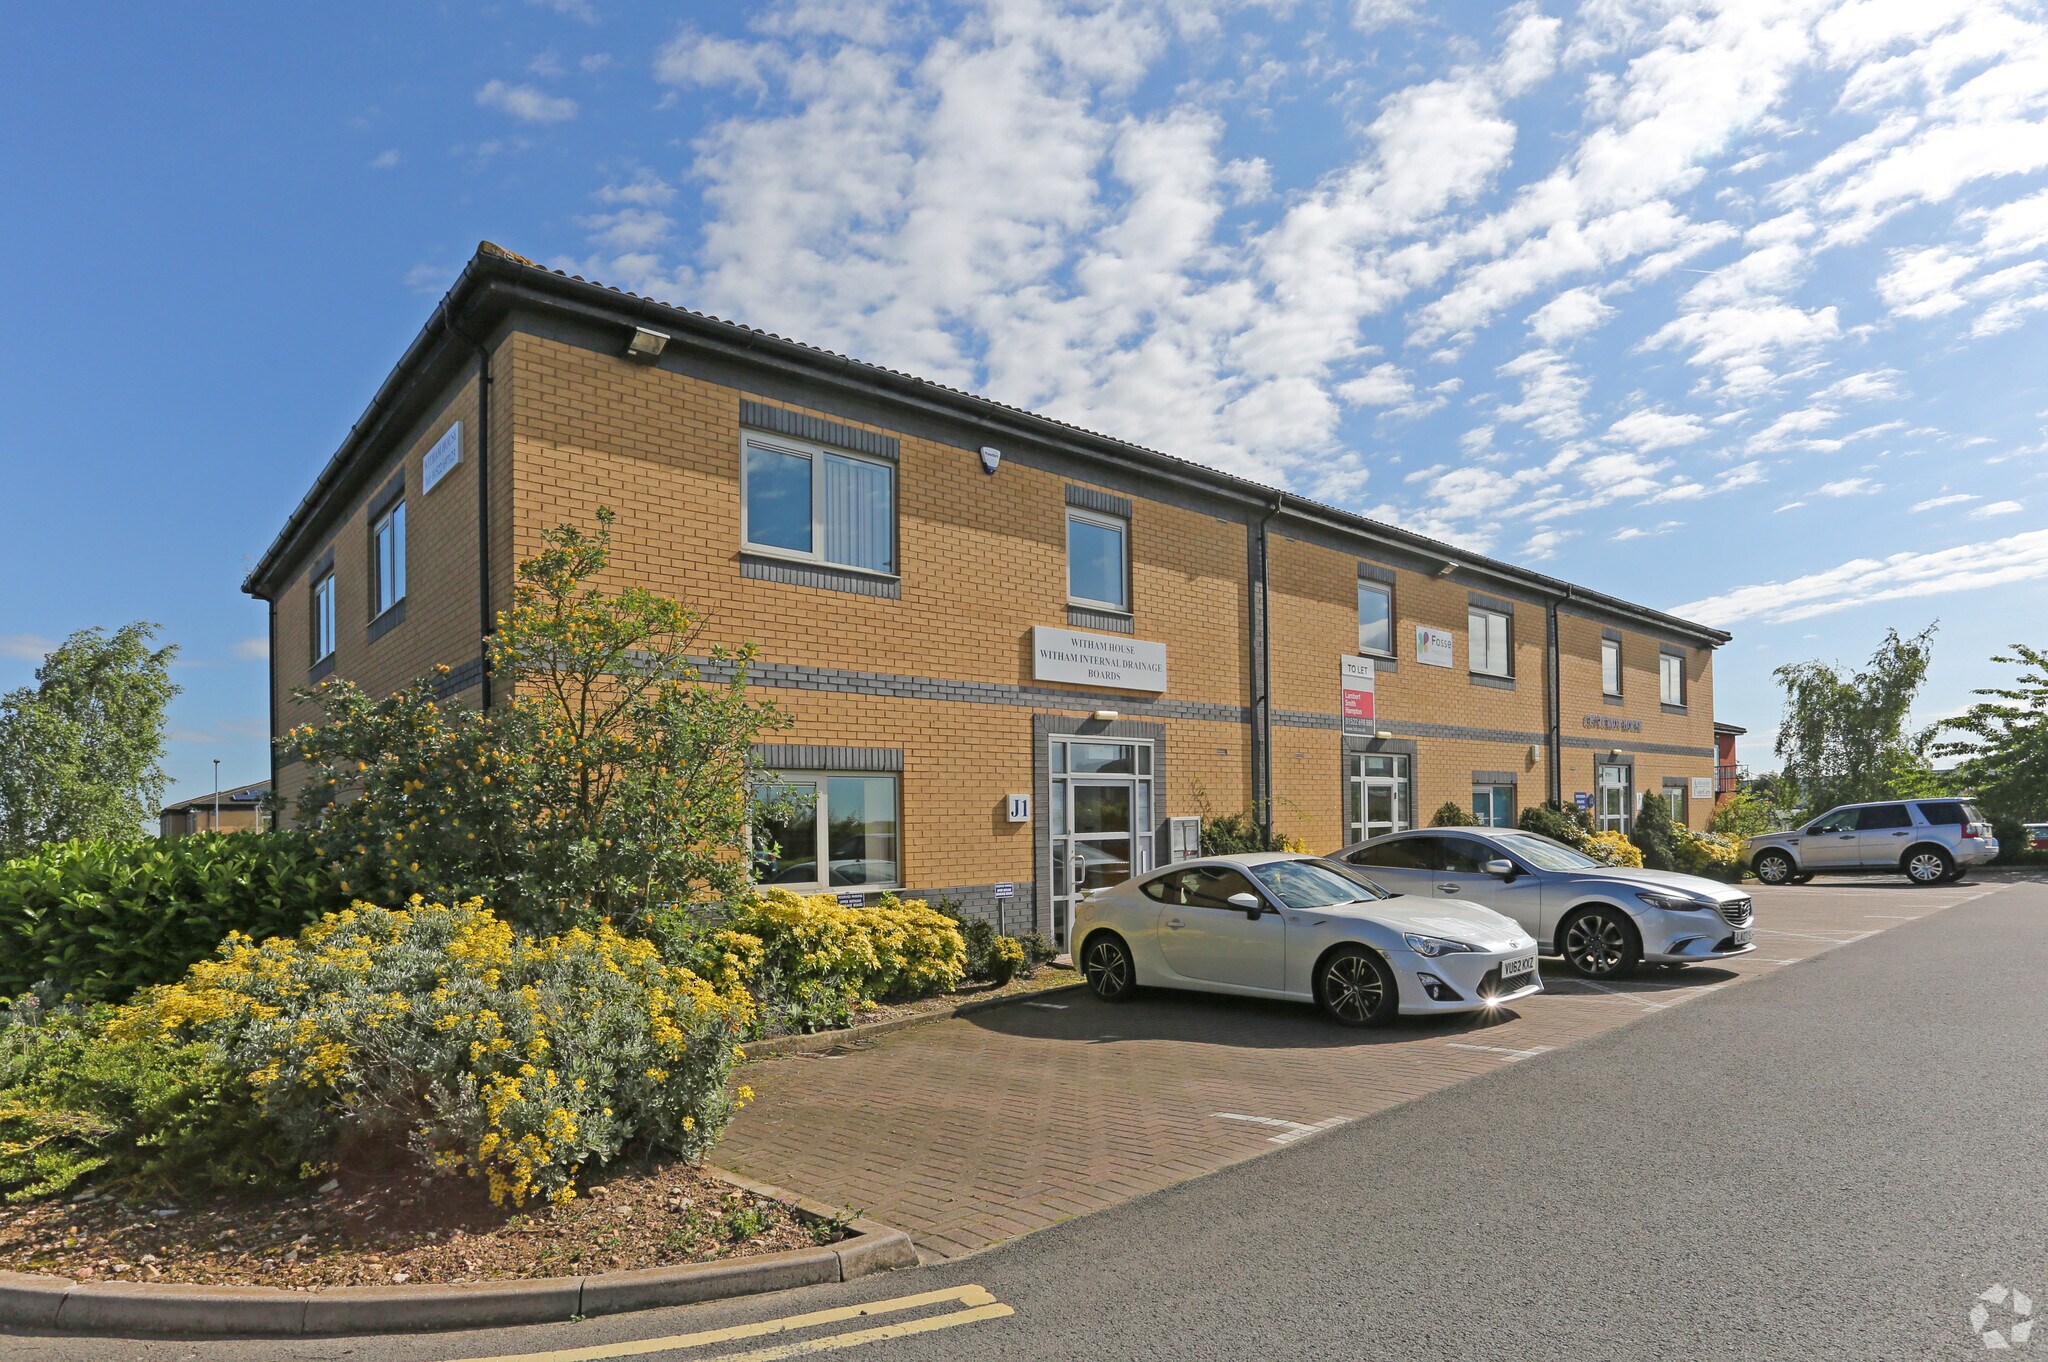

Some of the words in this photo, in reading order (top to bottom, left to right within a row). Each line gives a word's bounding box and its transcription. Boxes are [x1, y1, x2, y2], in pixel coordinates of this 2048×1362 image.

[1071, 638, 1108, 651] WITHAM
[1109, 643, 1135, 655] HOUSE
[1431, 634, 1452, 649] Fosse
[1040, 649, 1078, 662] WITHAM
[1079, 655, 1121, 668] INTERNAL
[1122, 660, 1163, 672] DRAINAGE
[1088, 669, 1121, 681] BOARDS
[1347, 664, 1356, 673] TO
[1357, 666, 1368, 675] LET
[1010, 799, 1028, 818] J1
[1522, 957, 1534, 971] KXZ
